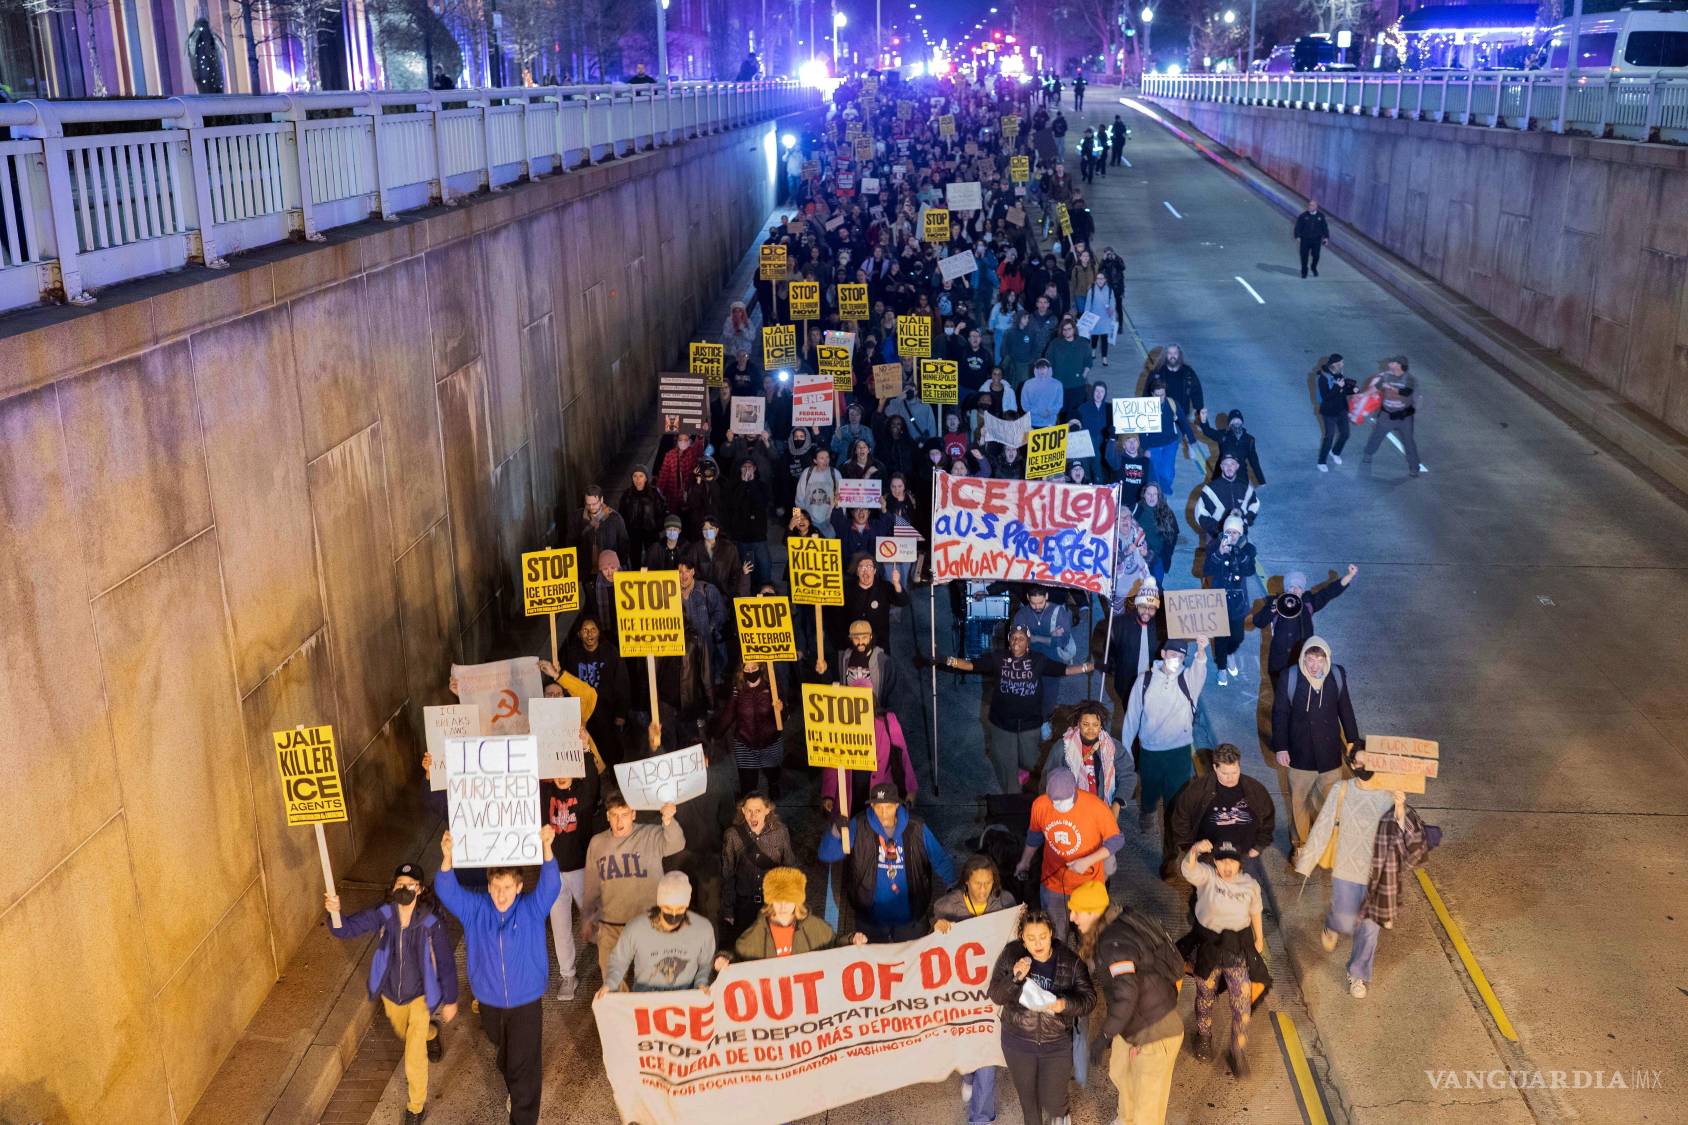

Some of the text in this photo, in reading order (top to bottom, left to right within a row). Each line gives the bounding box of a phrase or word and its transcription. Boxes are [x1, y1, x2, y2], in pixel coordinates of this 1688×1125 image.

[926, 213, 948, 226] STOP
[761, 246, 786, 256] DC
[791, 285, 818, 300] STOP
[840, 287, 866, 302] STOP
[764, 326, 794, 335] JAIL
[899, 324, 930, 337] KILLER
[765, 333, 795, 348] KILLER
[900, 337, 930, 348] ICE
[693, 346, 722, 358] JUSTICE
[766, 347, 796, 360] ICE
[819, 347, 850, 360] DC
[692, 357, 721, 365] FOR
[922, 362, 957, 375] DC
[692, 365, 721, 376] RENEE
[922, 373, 957, 382] MINNEAPOLIS
[833, 376, 852, 385] ERROR
[922, 382, 957, 390] STOP
[922, 389, 957, 399] ICE TERROR
[1113, 400, 1160, 415] ABOLISH
[1120, 413, 1160, 431] ICE
[1031, 428, 1067, 453] STOP
[1028, 450, 1065, 466] ICE TERROR
[1030, 461, 1063, 473] NOW
[938, 473, 1010, 515] ICE
[791, 539, 839, 552] JAIL
[527, 553, 575, 583] STOP
[792, 551, 839, 572] KILLER
[794, 571, 841, 589] ICE
[526, 581, 577, 599] ICE TERROR
[620, 580, 677, 611] STOP
[794, 587, 842, 596] AGENTS
[529, 594, 575, 608] NOW
[1168, 593, 1225, 613] AMERICA
[739, 603, 788, 628] STOP
[1177, 611, 1218, 634] KILLS
[620, 617, 681, 631] ICE TERROR
[625, 633, 679, 643] NOW
[741, 631, 792, 645] ICE TERROR
[745, 644, 791, 653] NOW
[1002, 659, 1033, 670] ICE
[1001, 669, 1033, 680] KILLED
[808, 693, 870, 726] STOP
[277, 728, 331, 749] JAIL
[807, 729, 873, 746] ICE TERROR
[451, 738, 531, 775] ICE
[812, 745, 870, 756] NOW
[279, 745, 335, 777] KILLER
[627, 751, 705, 788] ABOLISH
[285, 775, 341, 802] ICE
[449, 774, 539, 801] MURDERED
[290, 798, 342, 812] AGENTS
[451, 801, 468, 828] A
[468, 800, 536, 829] WOMAN
[634, 941, 988, 1042] ICE OUT OF DC
[638, 1040, 702, 1058] STOP
[751, 996, 929, 1041] DEPORTATIONS
[934, 988, 991, 1006] NOW
[639, 1055, 665, 1072] ICE
[668, 1052, 721, 1078] FUERA
[725, 1047, 750, 1065] DE
[789, 1040, 813, 1059] NO
[816, 1028, 854, 1051] MÁS
[859, 1004, 994, 1036] DEPORTACIONES
[672, 1084, 696, 1096] FOR
[698, 1071, 762, 1091] SOCIALISM
[764, 1073, 774, 1082] &
[775, 1053, 838, 1082] LIBERATION
[847, 1037, 922, 1057] WASHINGTON
[950, 1025, 994, 1037] @PSLDC
